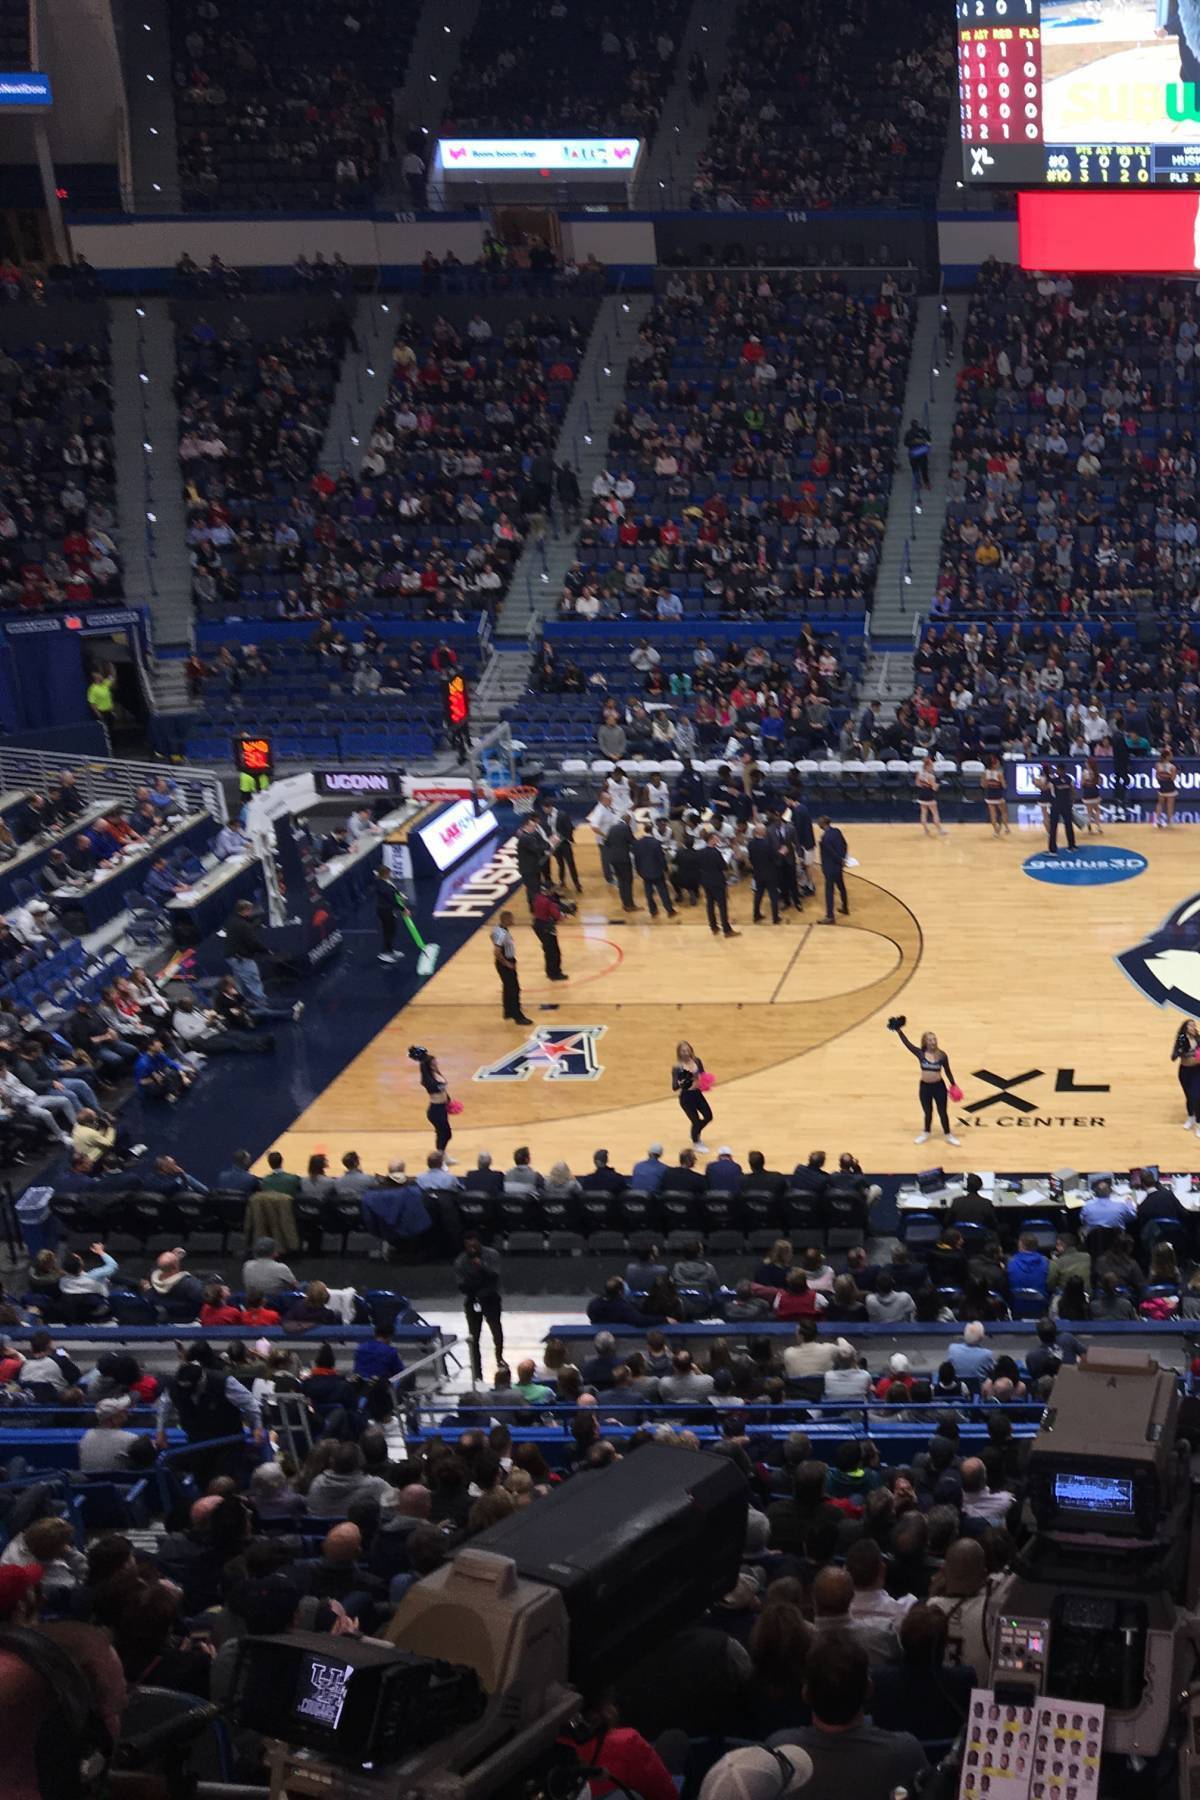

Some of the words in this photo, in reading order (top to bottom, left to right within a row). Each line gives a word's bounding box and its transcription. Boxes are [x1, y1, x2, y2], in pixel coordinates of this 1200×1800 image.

[325, 773, 389, 791] UCONN
[1021, 857, 1146, 870] genius3D
[962, 1069, 1110, 1113] XL
[956, 1117, 989, 1127] XL
[996, 1117, 1106, 1127] CENTER
